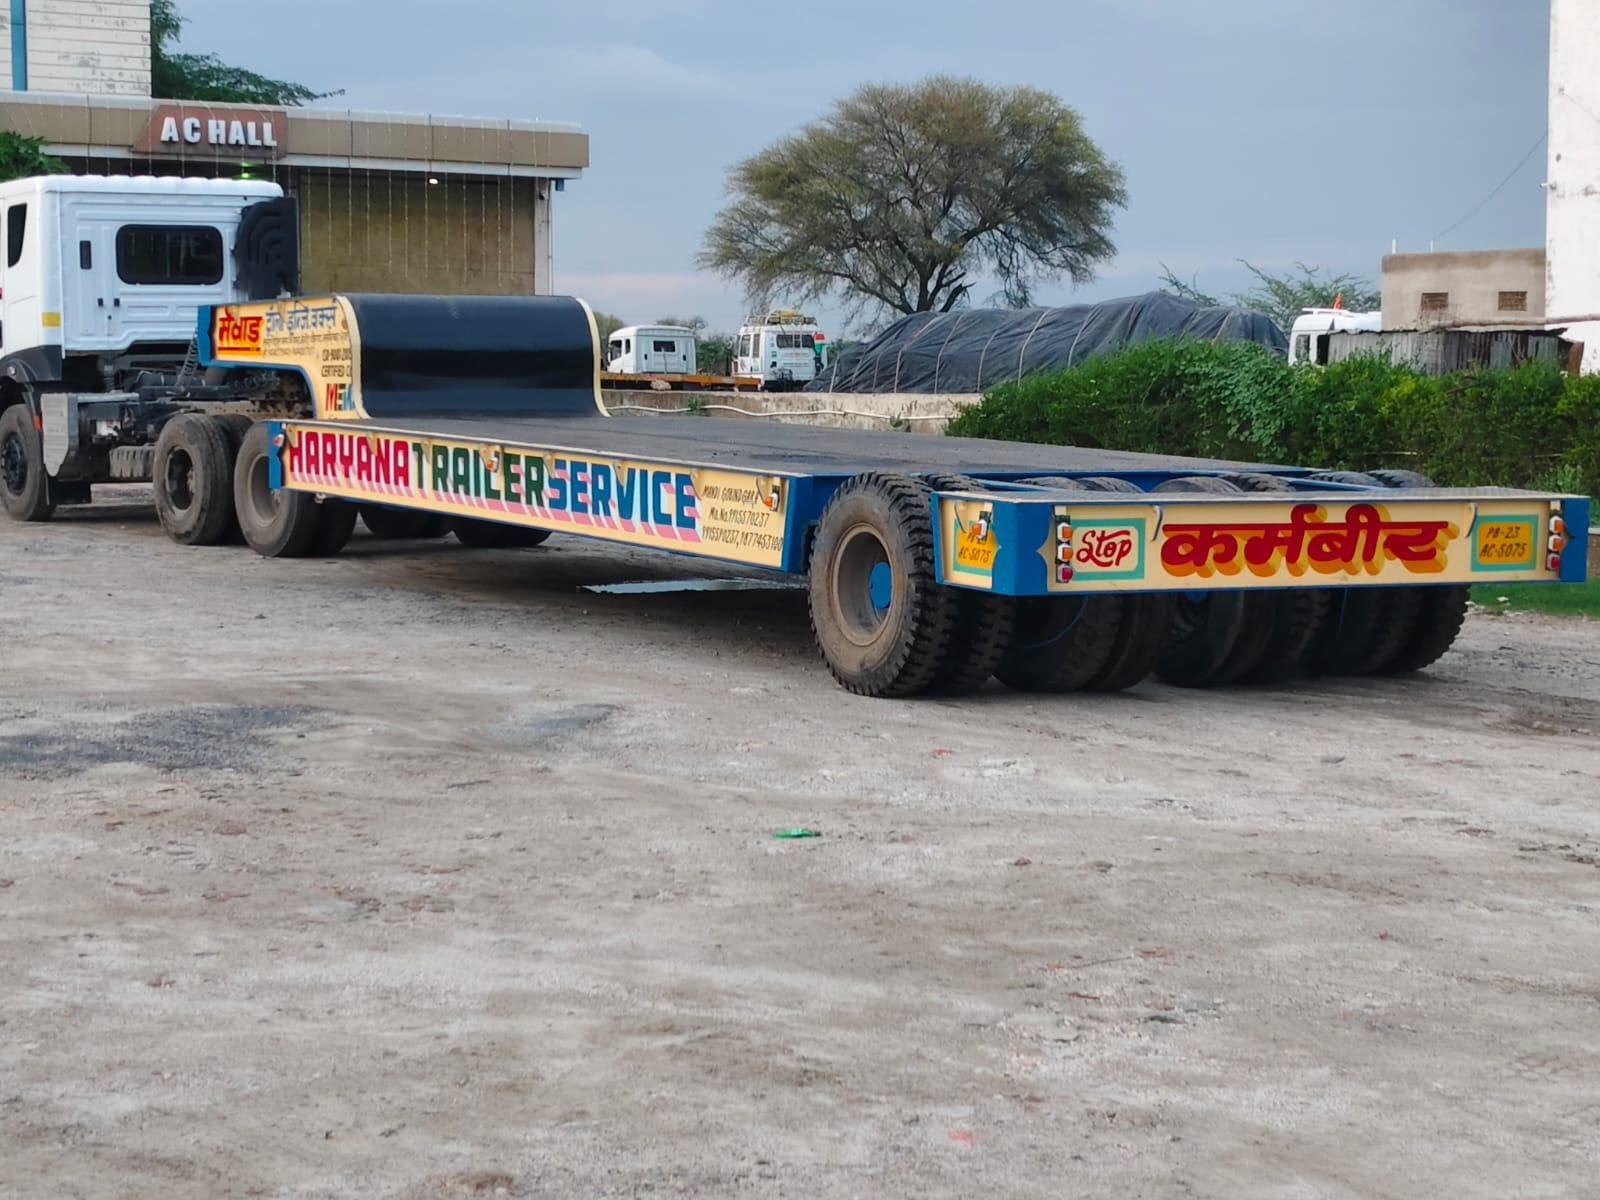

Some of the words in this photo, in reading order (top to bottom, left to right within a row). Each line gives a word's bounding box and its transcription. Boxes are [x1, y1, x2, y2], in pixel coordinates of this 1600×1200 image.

[160, 116, 201, 143] AC
[207, 119, 278, 147] HALL
[290, 429, 410, 488] HARYANA
[411, 442, 545, 508] TRAILER
[548, 458, 697, 531] SERVICE
[1076, 530, 1133, 567] Stop
